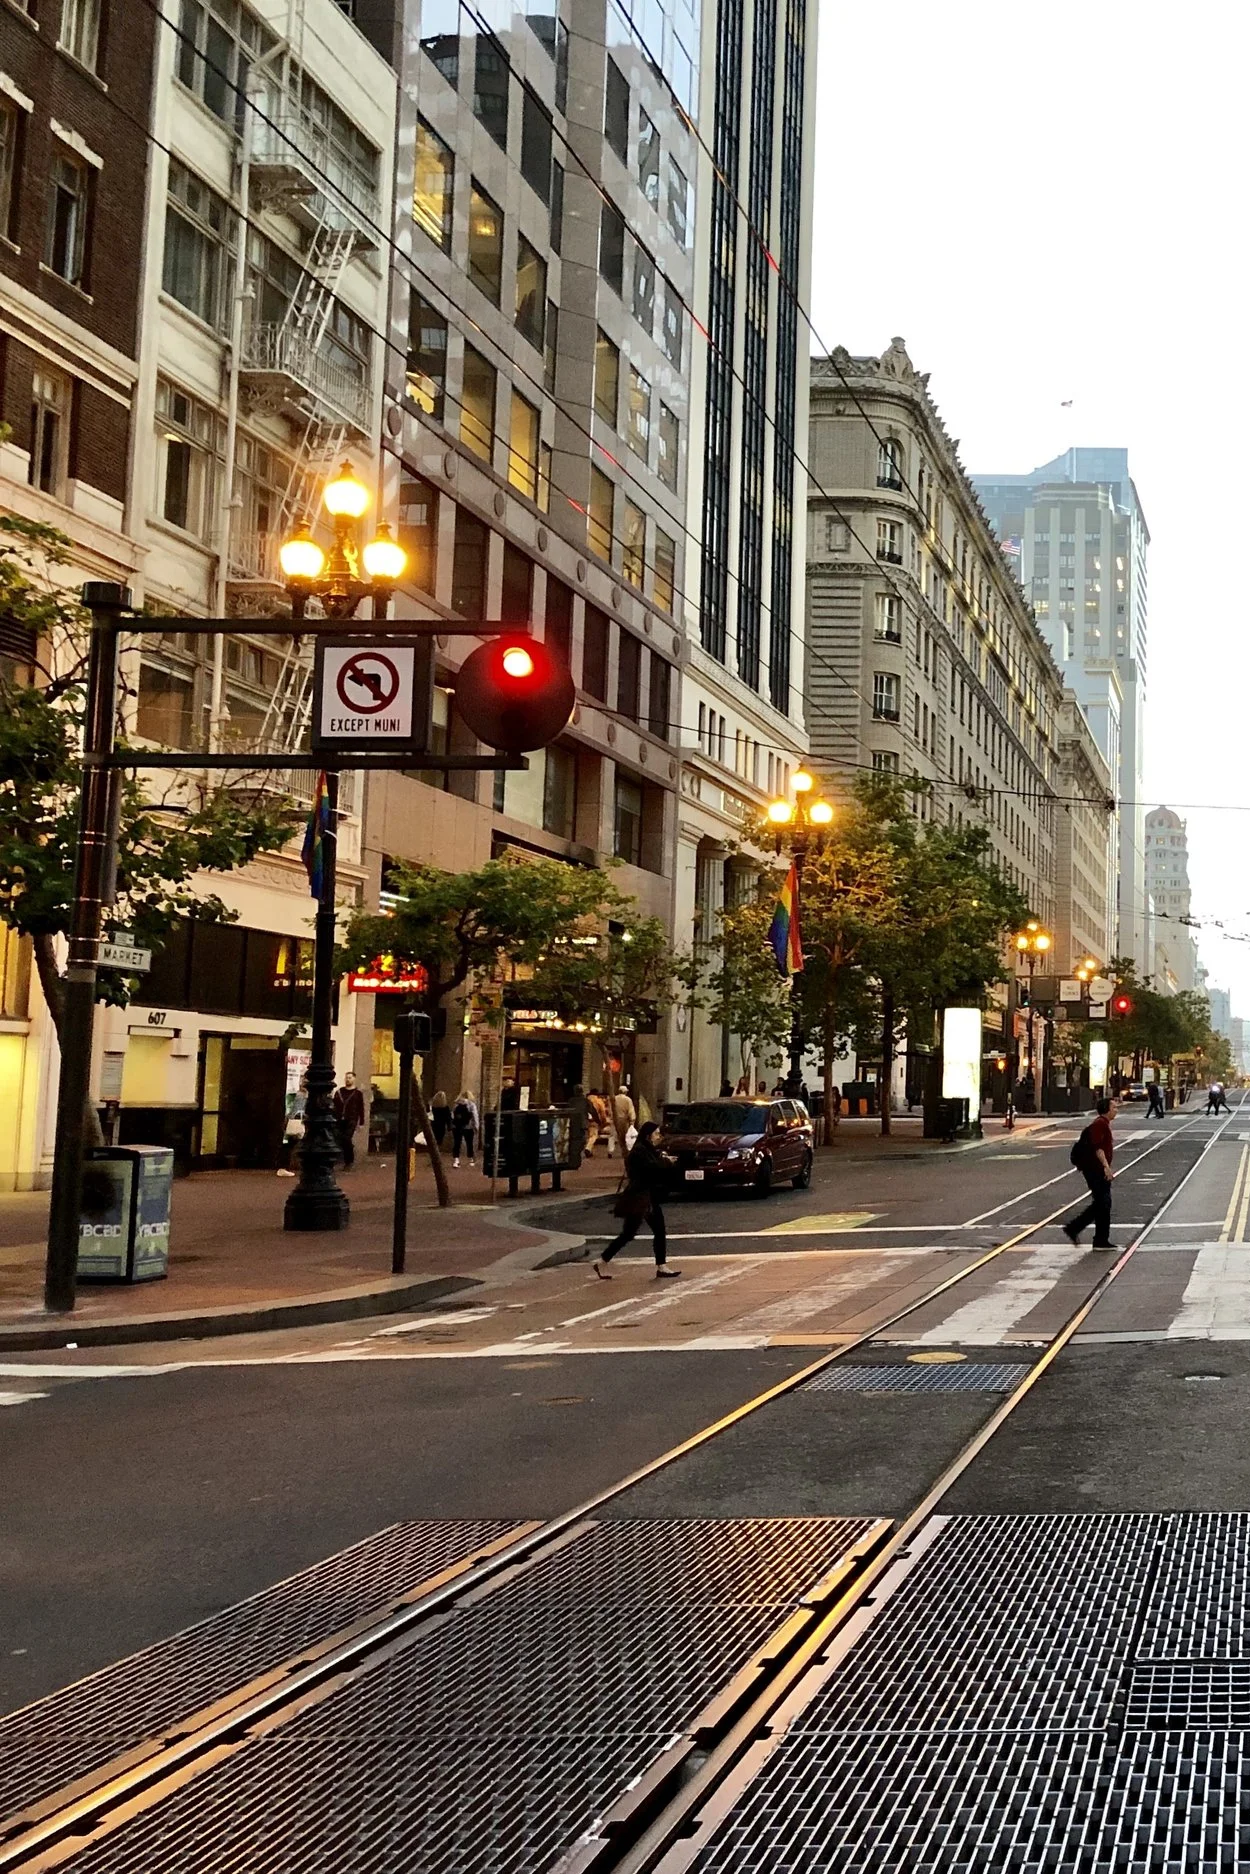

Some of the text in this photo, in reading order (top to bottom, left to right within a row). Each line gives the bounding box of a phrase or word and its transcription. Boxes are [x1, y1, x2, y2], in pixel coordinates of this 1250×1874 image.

[330, 718, 401, 732] EXCEPT MUNI
[103, 947, 144, 965] MARKET
[147, 1011, 167, 1025] 607
